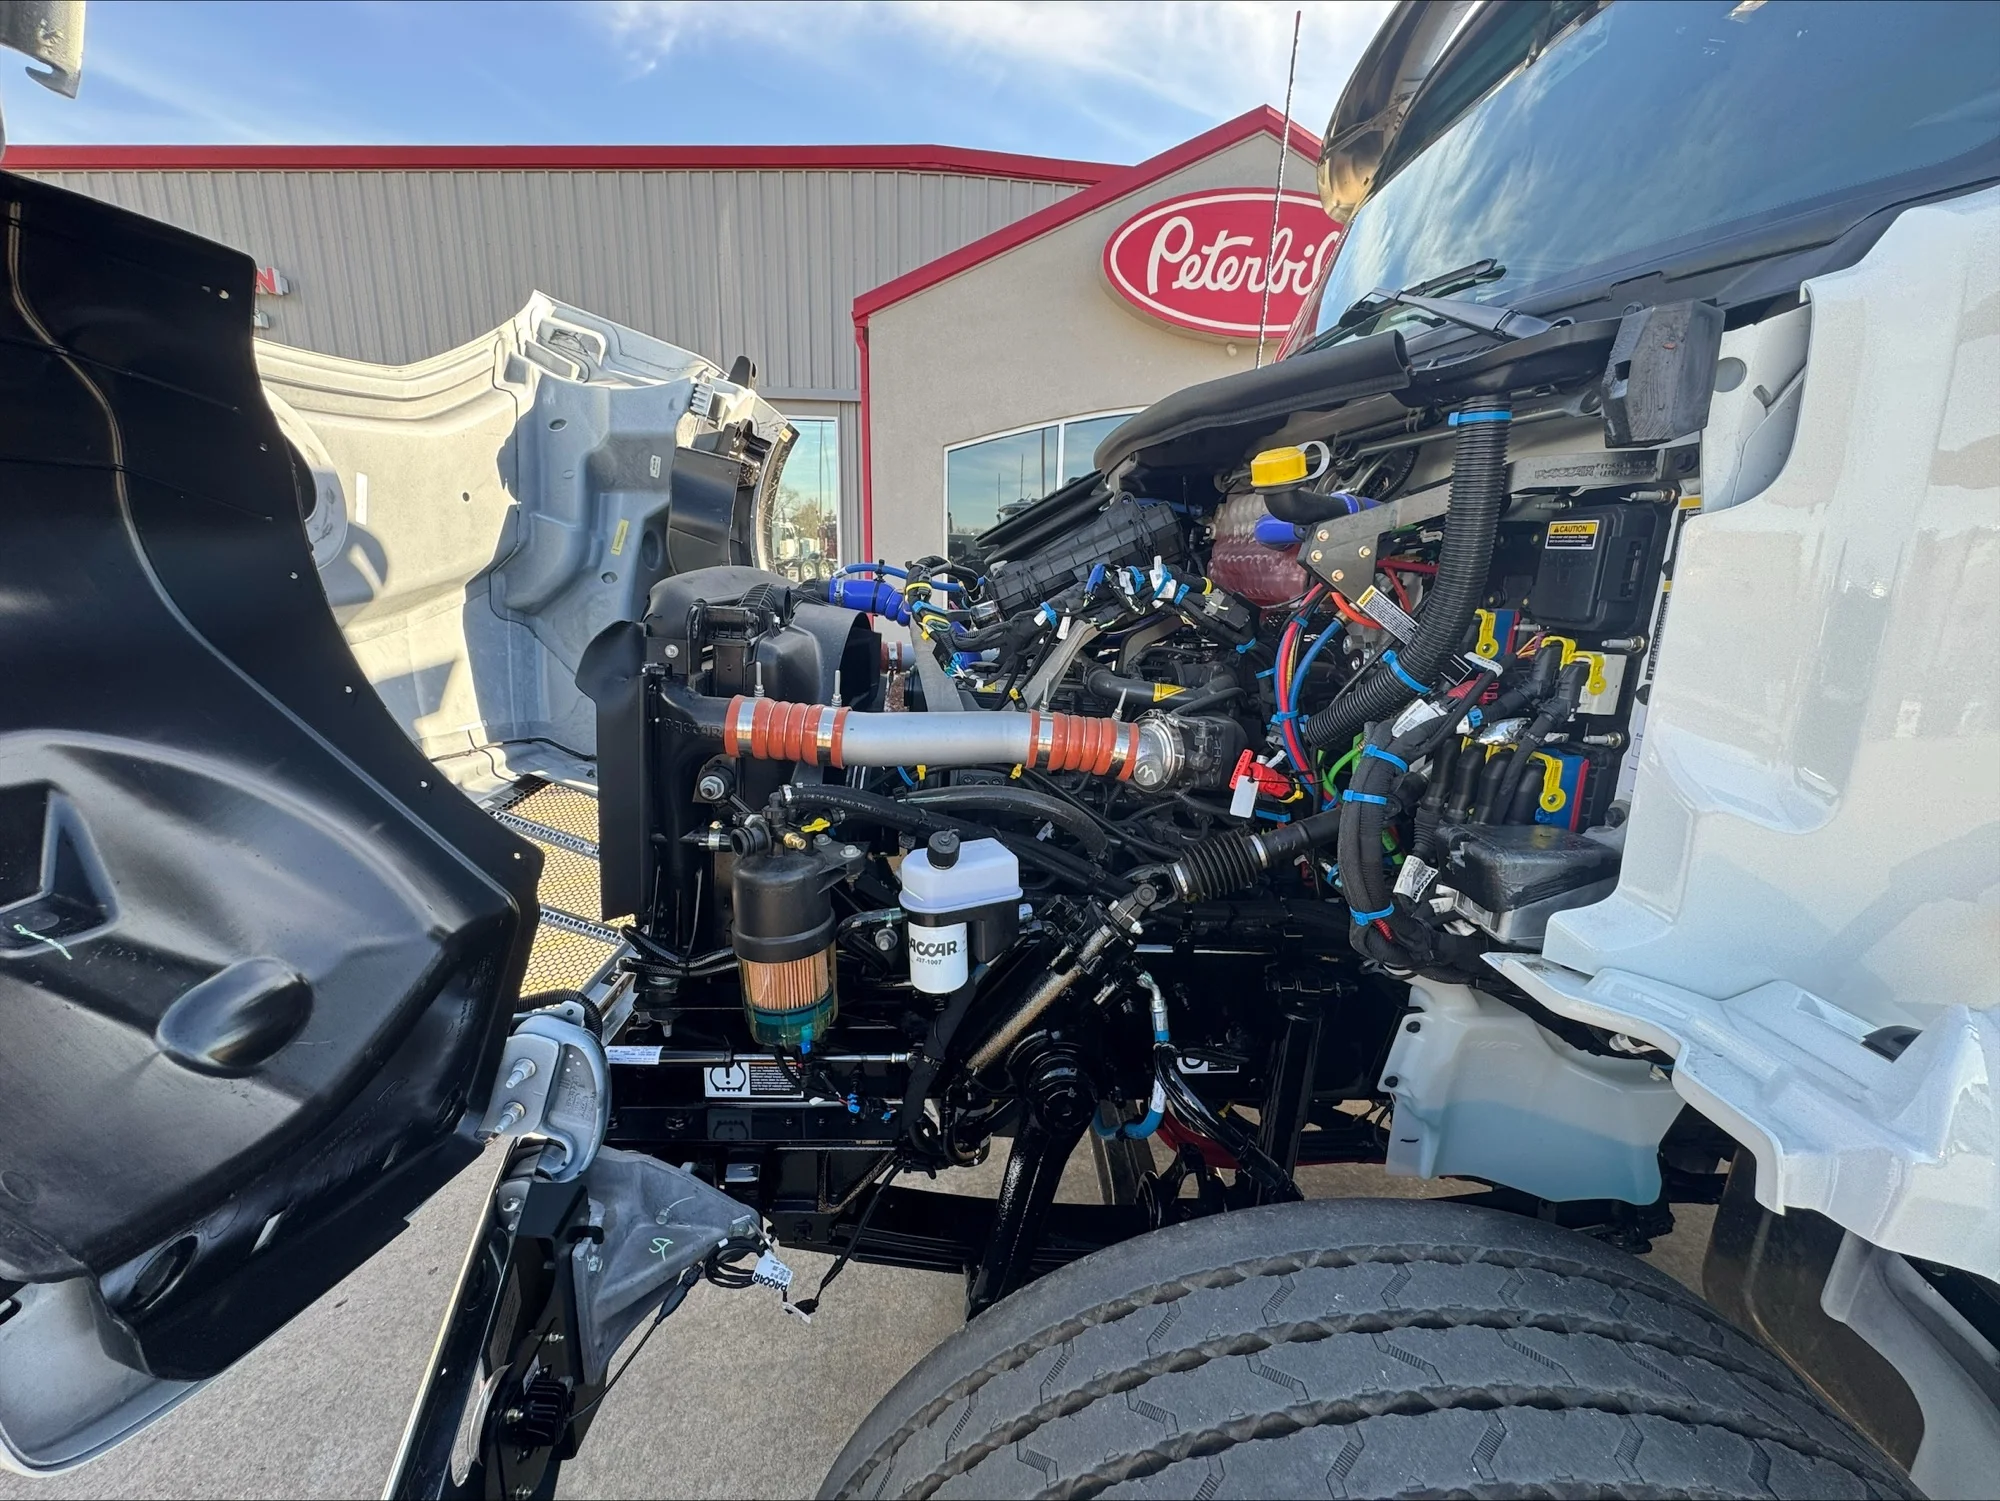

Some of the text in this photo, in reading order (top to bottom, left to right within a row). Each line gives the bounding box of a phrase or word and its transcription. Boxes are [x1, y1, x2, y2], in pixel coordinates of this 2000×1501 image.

[1146, 215, 1341, 296] Peterbil
[1559, 525, 1588, 533] CAUTION
[908, 937, 958, 958] ACCAR
[753, 1272, 789, 1292] PACCAR
